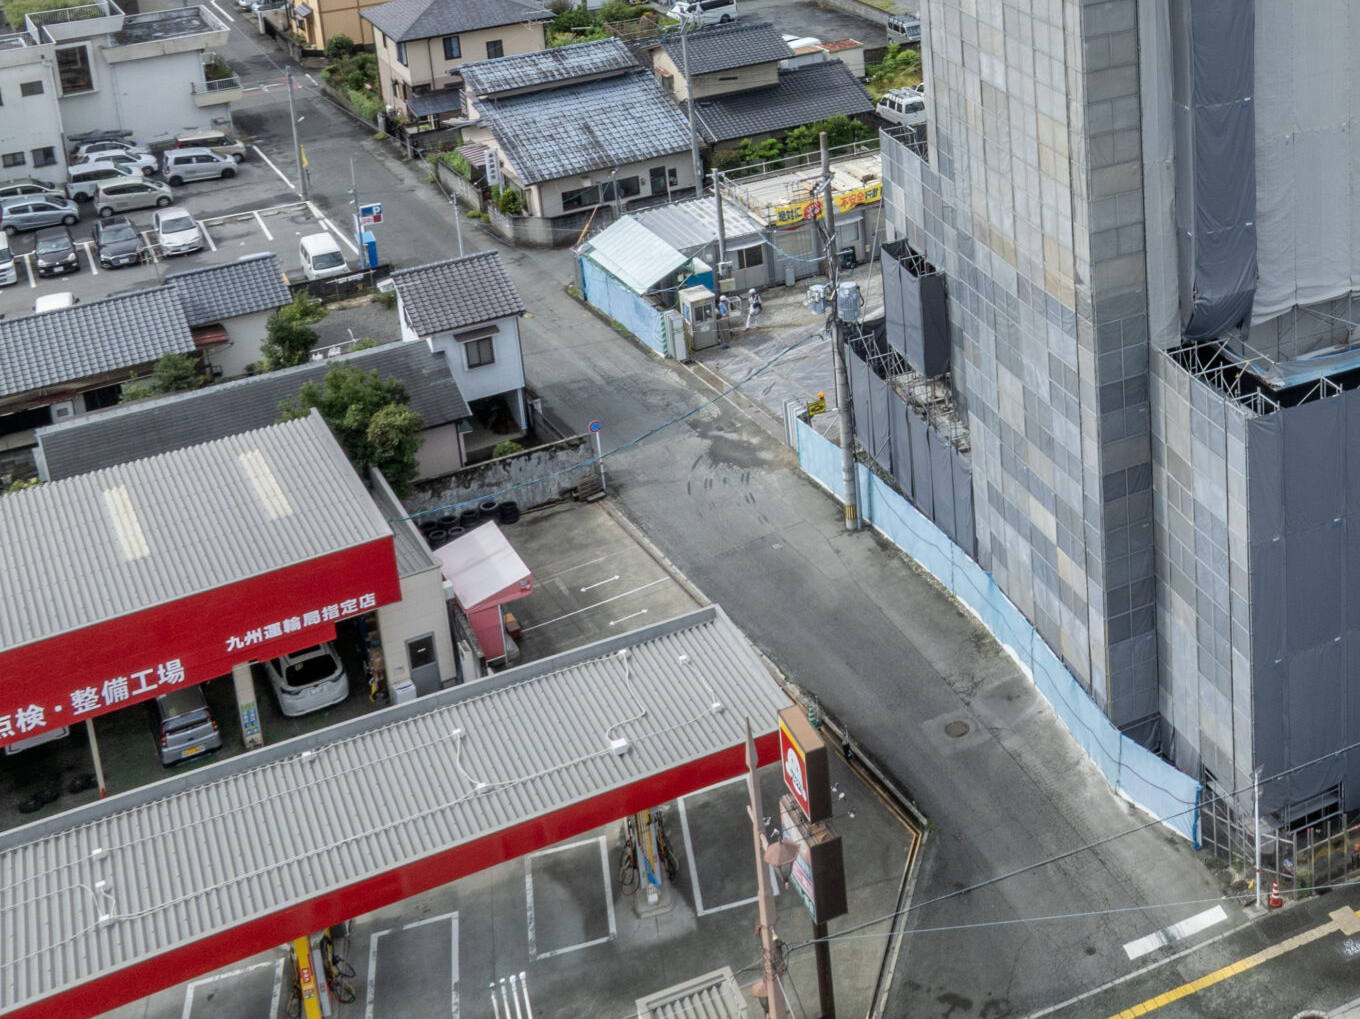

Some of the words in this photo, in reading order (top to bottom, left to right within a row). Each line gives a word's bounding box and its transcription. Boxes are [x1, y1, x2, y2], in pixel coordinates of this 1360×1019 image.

[372, 206, 381, 215] P
[225, 592, 376, 652] 九州運輸局指定店
